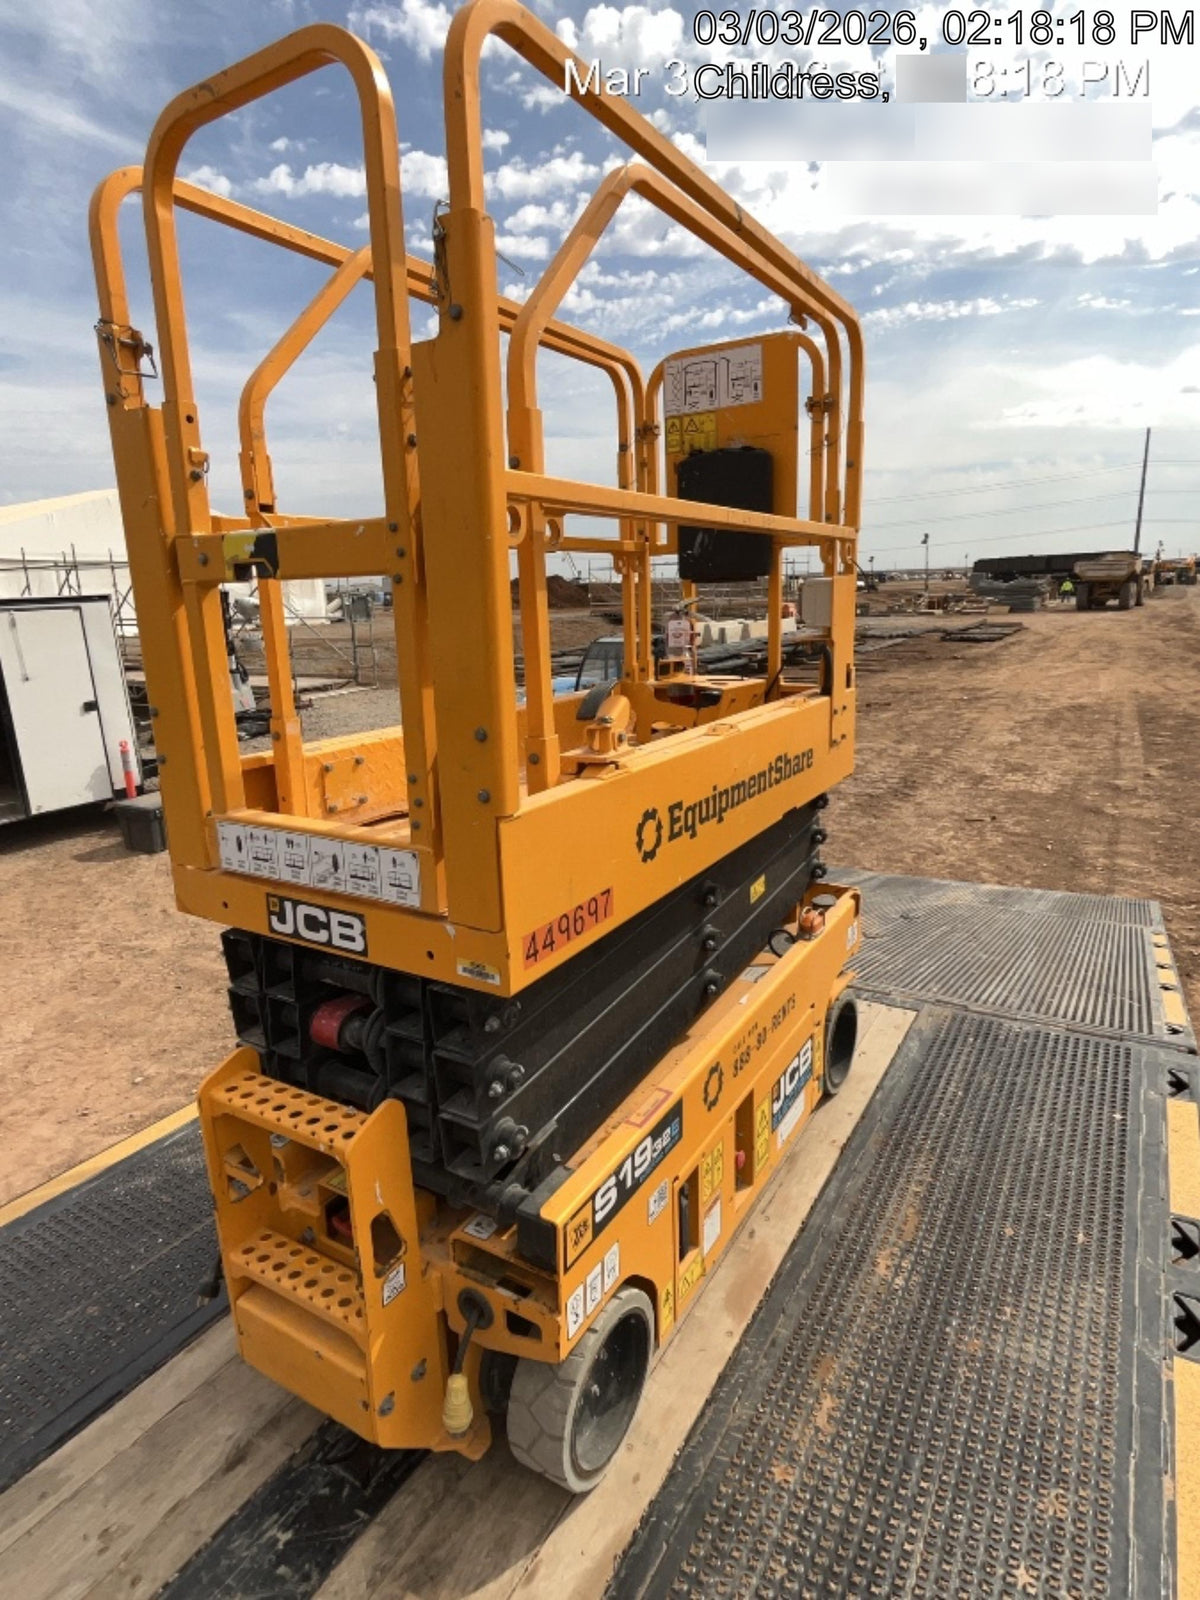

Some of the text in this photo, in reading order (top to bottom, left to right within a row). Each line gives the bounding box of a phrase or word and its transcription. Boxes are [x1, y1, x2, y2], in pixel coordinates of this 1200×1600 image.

[668, 749, 813, 843] EquipmentShare
[270, 901, 365, 951] JCB
[525, 888, 611, 962] 449697
[773, 1039, 812, 1114] JCB
